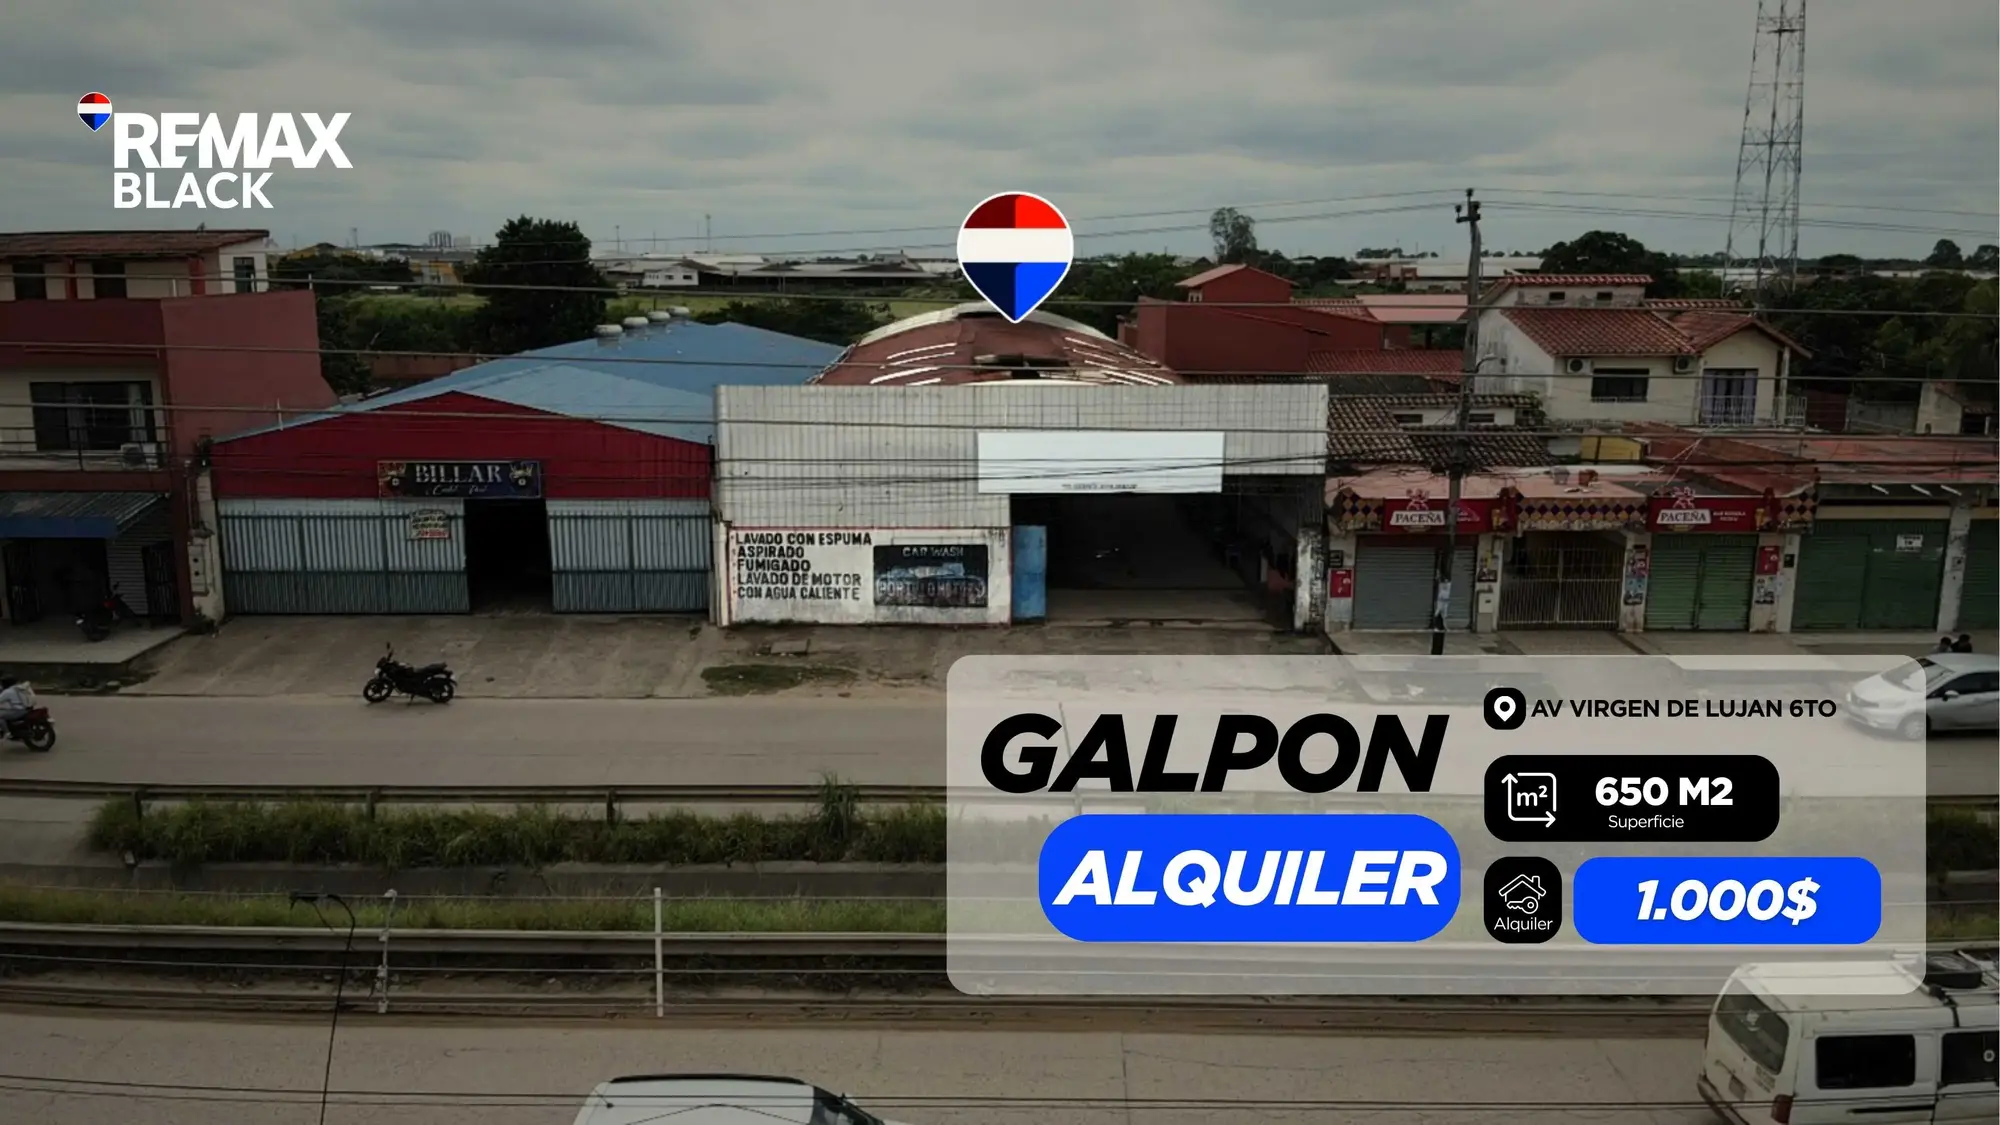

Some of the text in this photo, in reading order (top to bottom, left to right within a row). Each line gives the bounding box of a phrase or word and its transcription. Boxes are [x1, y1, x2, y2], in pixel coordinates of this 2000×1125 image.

[415, 464, 502, 483] BILLAR
[1395, 511, 1441, 524] PACEÑA
[1660, 511, 1707, 522] PACEÑA
[735, 532, 872, 545] LAVADO CON ESPUMA
[737, 545, 805, 558] ASPIRADO
[902, 547, 964, 557] CAR WASH
[737, 559, 811, 572] FUMIGADO
[737, 572, 861, 586] LAVADO DE MOTOR
[737, 586, 861, 600] CON AGUA CALIENTE
